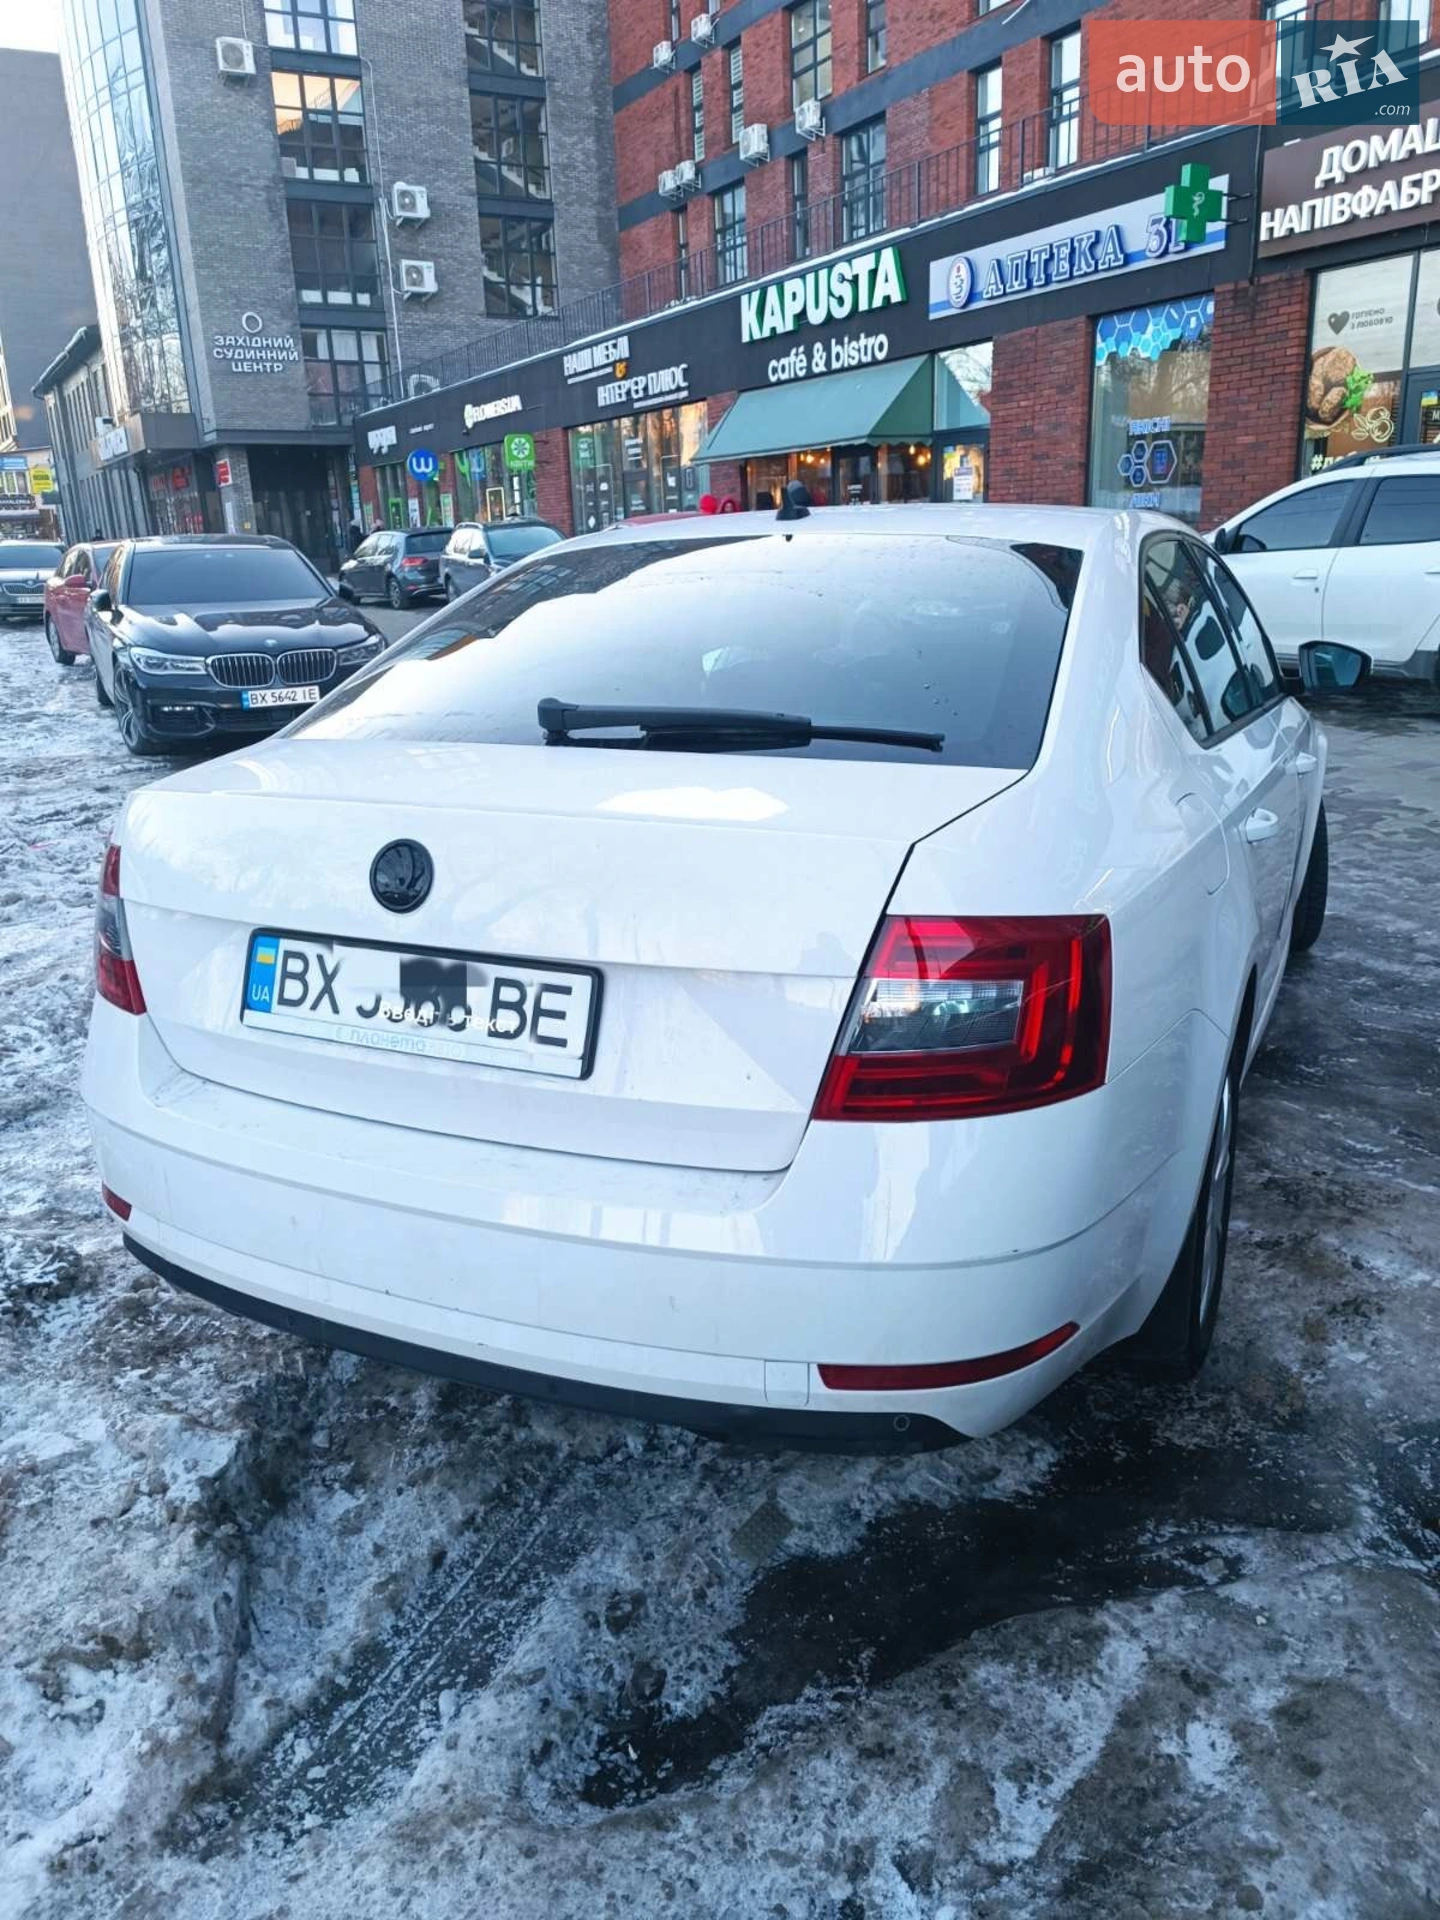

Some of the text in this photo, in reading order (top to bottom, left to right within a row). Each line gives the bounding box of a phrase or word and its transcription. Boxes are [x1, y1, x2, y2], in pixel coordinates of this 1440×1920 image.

[983, 224, 1125, 299] АПТЕКА
[741, 246, 907, 344] KAPUSTA
[213, 335, 295, 348] ЗАХІДНИЙ
[213, 348, 299, 361] СУДИННИЙ
[768, 332, 889, 383] café & bistro
[232, 361, 283, 373] ЦЕНТР
[250, 688, 317, 705] BX 5642 IE
[251, 984, 270, 1003] UA
[276, 949, 342, 1016] BX
[487, 976, 573, 1048] BE
